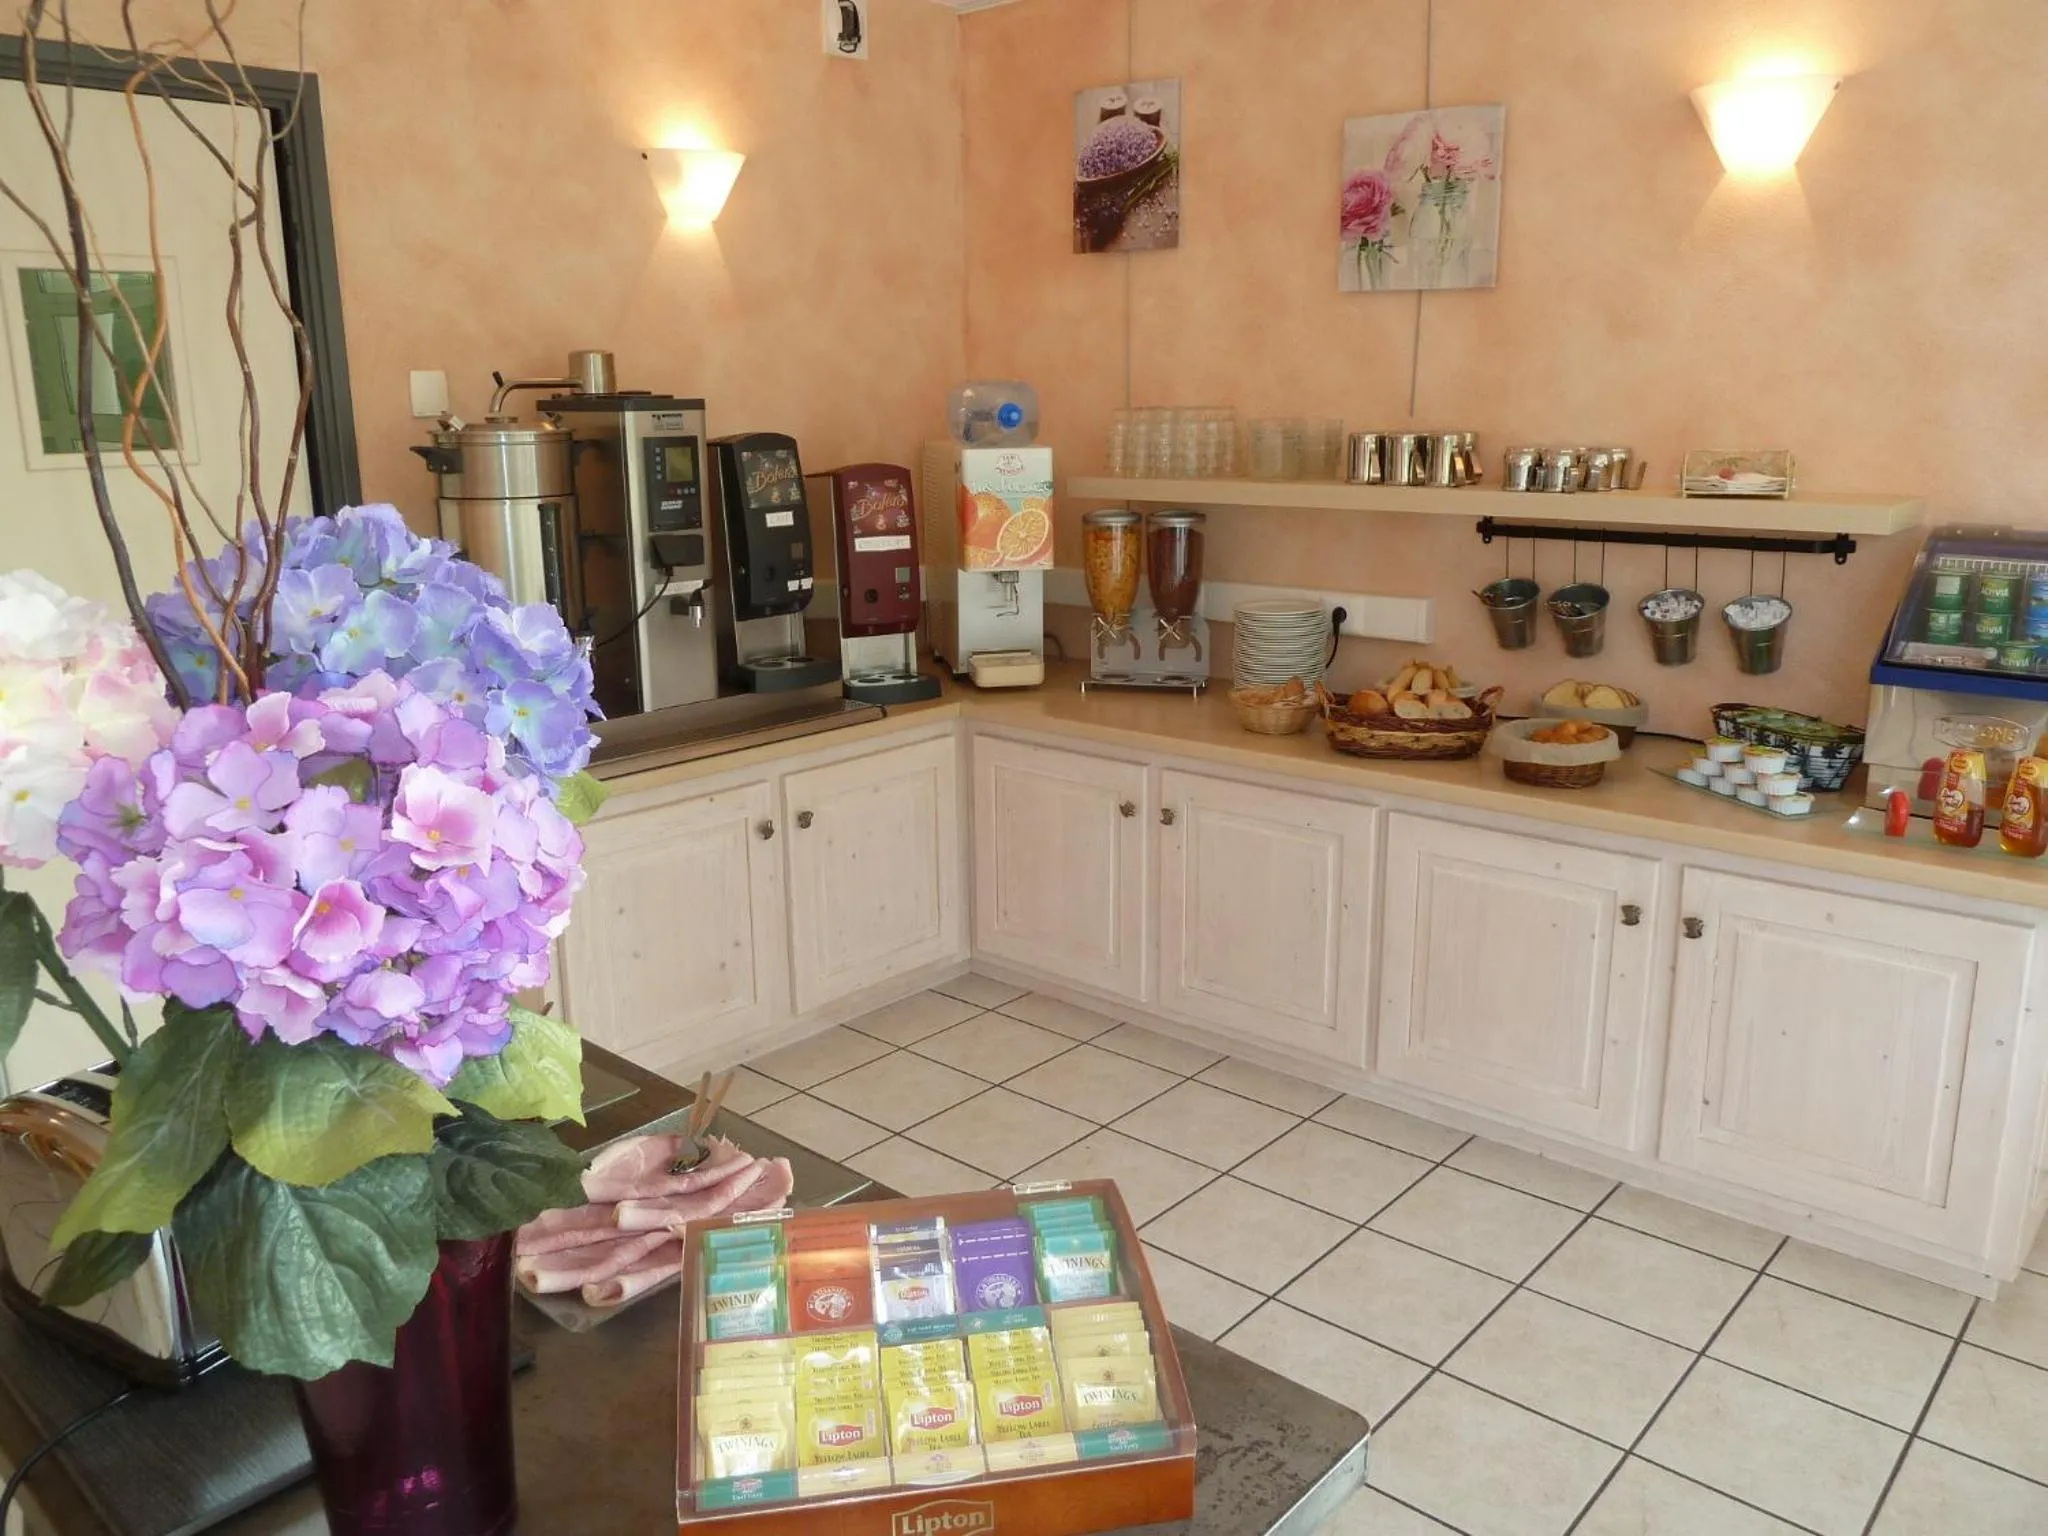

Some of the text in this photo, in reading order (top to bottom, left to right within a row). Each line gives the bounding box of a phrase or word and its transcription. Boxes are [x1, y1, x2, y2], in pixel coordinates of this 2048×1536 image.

[1049, 1255, 1105, 1276] TININGS
[711, 1290, 768, 1312] TWINING
[1083, 1387, 1137, 1404] TWININGS
[1003, 1400, 1040, 1415] Lipton
[913, 1413, 952, 1427] Lipton
[821, 1430, 861, 1443] Lipton
[902, 1511, 985, 1536] Lipton
